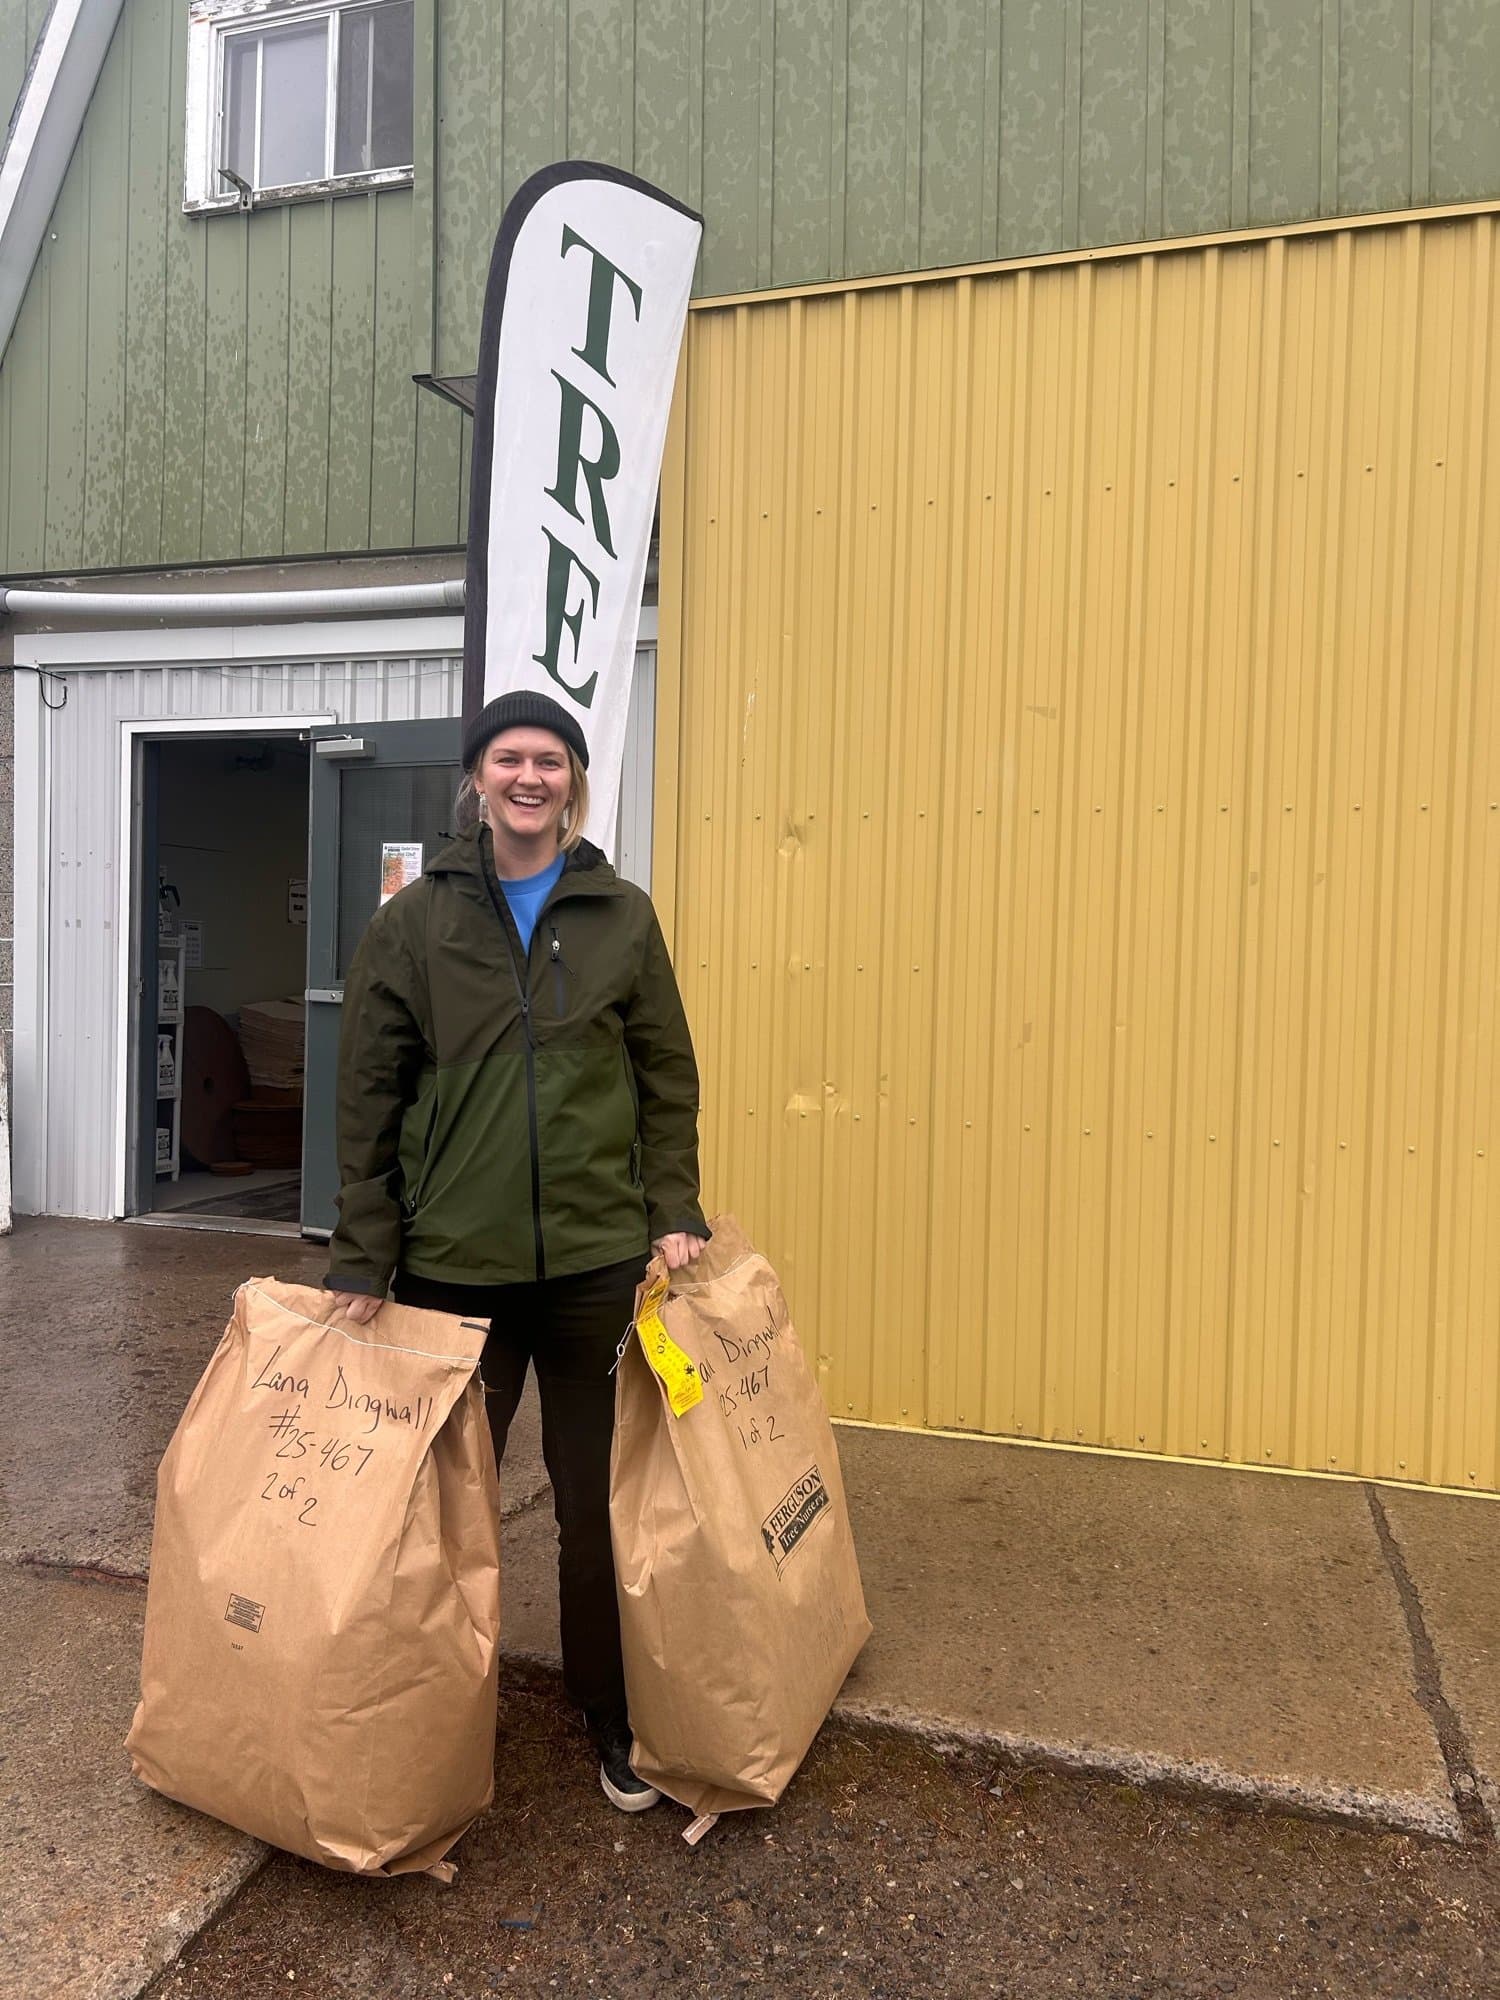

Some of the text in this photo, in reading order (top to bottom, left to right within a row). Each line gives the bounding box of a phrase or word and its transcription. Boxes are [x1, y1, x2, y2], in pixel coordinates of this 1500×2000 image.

[251, 1345, 433, 1434] Lana Dingwall
[750, 1417, 763, 1444] of
[766, 1415, 785, 1442] 2
[260, 1472, 319, 1527] 2 of 2
[769, 1469, 822, 1535] FERGUSON
[780, 1491, 826, 1549] Tree Nursery
